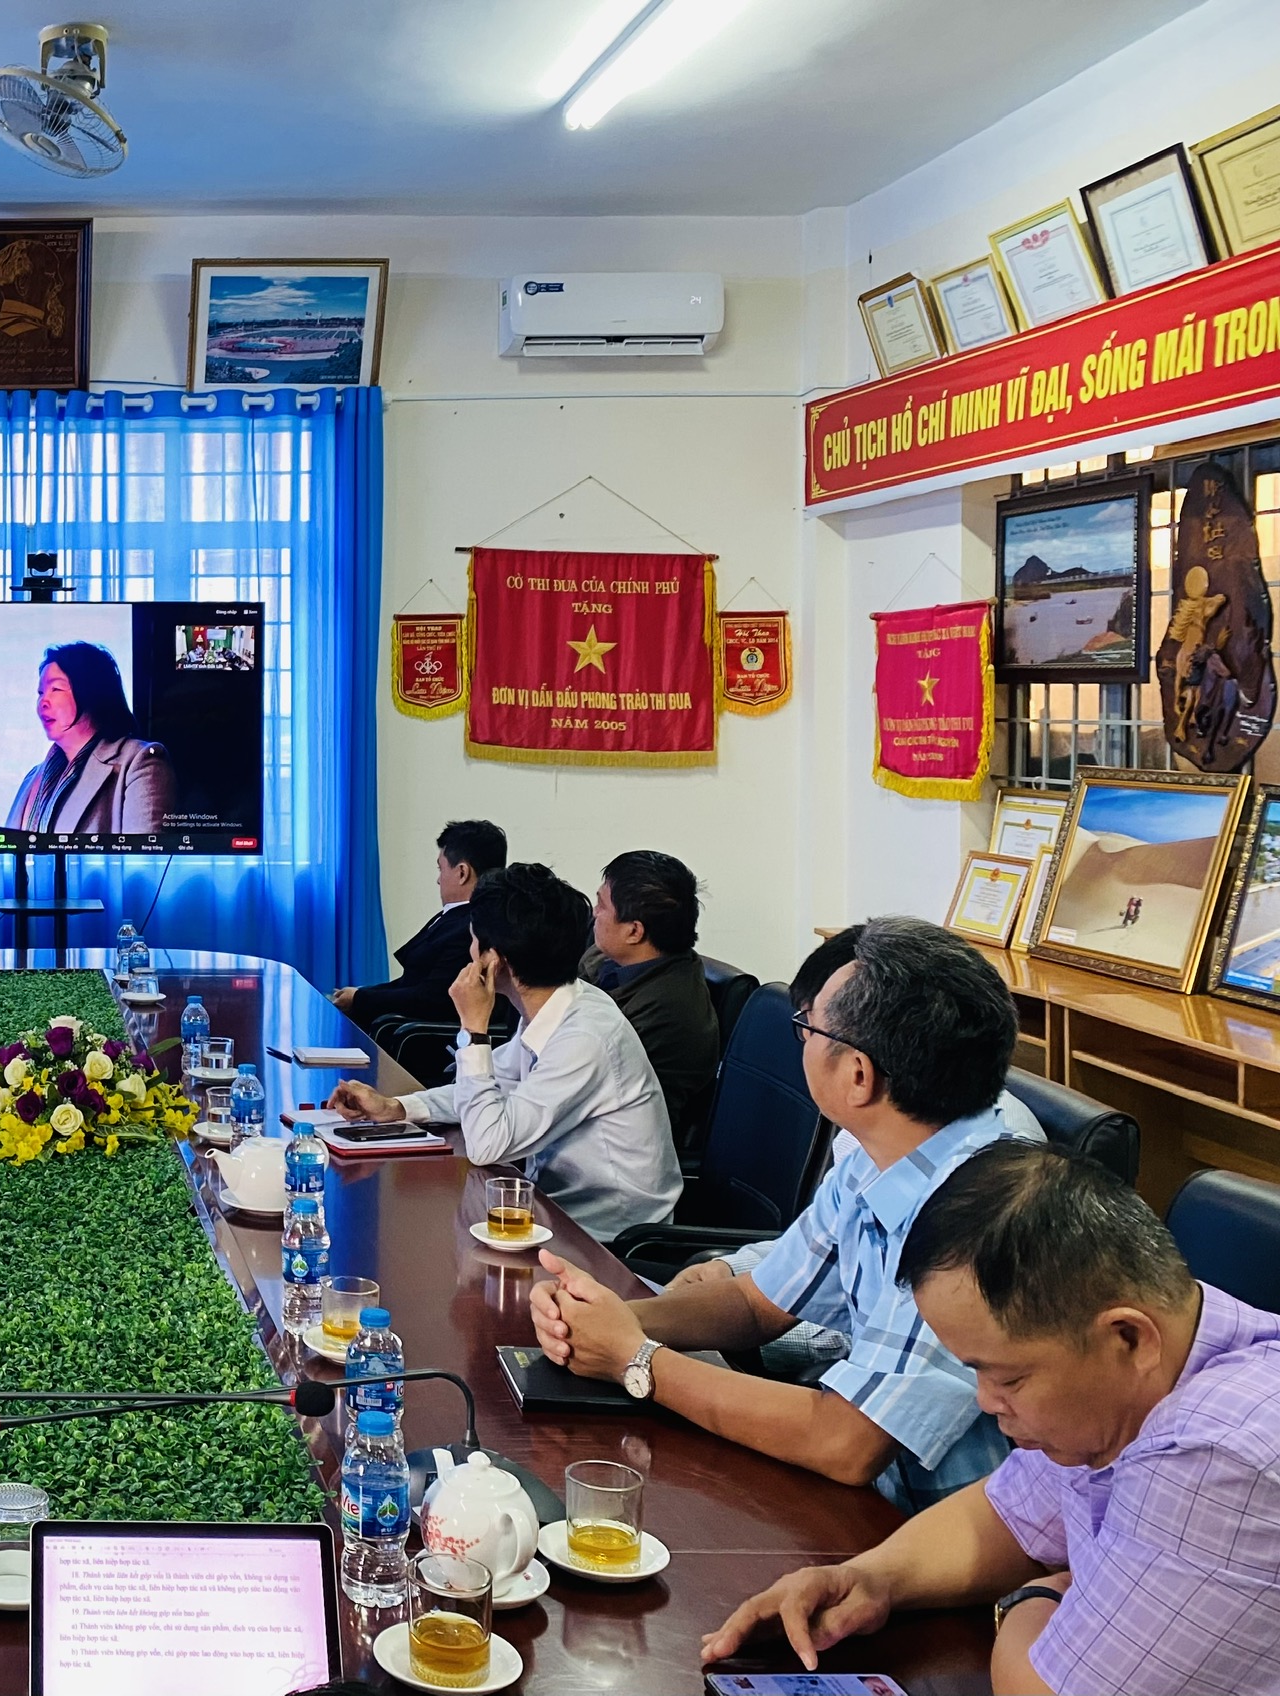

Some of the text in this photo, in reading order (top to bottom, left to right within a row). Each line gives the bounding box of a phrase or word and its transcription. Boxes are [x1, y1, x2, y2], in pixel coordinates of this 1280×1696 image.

[690, 296, 701, 304] 24
[822, 417, 851, 472] CHỦ
[854, 425, 886, 470] TỊCH
[891, 395, 913, 452] HỒ
[917, 389, 946, 442] CHÍ
[951, 383, 1000, 439] MINH
[1007, 366, 1030, 421] VĨ
[1031, 362, 1073, 422] ĐẠI,
[1080, 330, 1145, 405] SỐNG
[1152, 312, 1205, 384] MÃI
[506, 576, 679, 595] CỜ THI ĐUA CỦA CHÍNH PHỦ
[572, 602, 613, 615] TẶNG
[492, 682, 692, 711] ĐƠN VỊ DẪN ĐẦU PHONG TRÀO THI ĐUA
[551, 717, 627, 731] NĂM 2005
[342, 1495, 359, 1515] Vie
